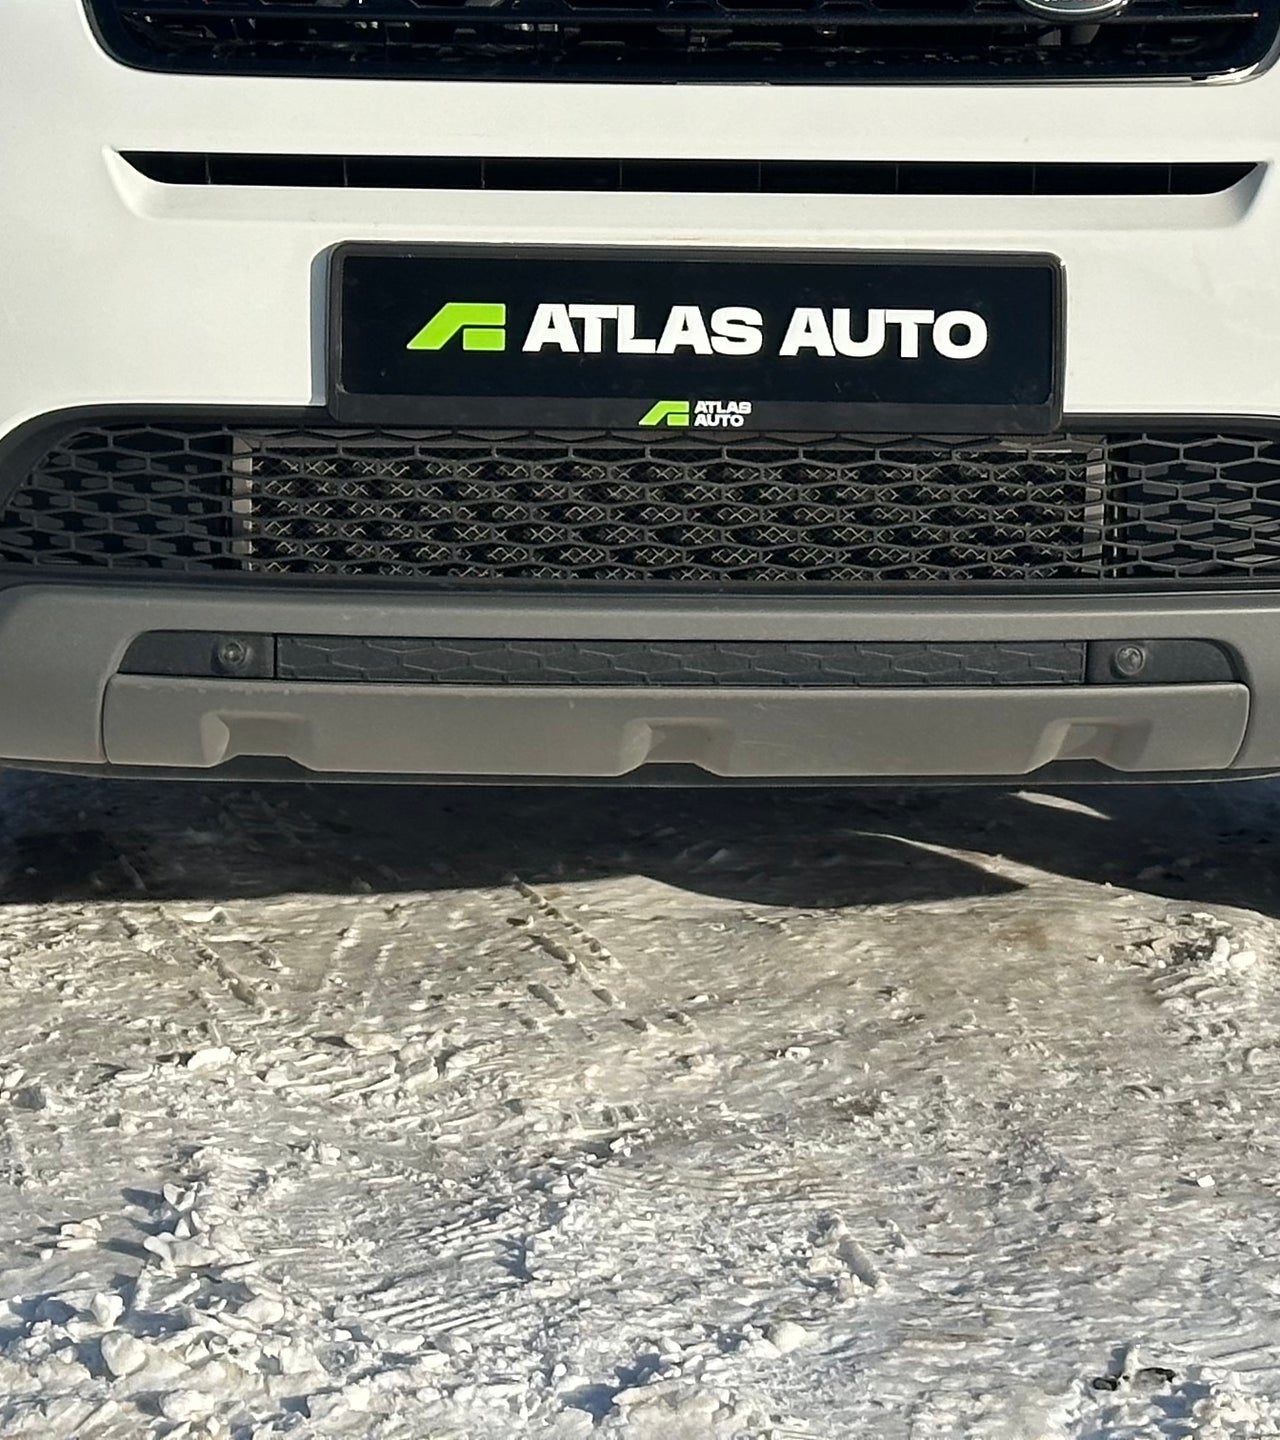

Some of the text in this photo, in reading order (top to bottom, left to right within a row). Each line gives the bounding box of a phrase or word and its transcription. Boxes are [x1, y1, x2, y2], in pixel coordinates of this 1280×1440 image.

[521, 303, 989, 359] ATLAS AUTO
[693, 400, 753, 415] ATLAS
[693, 413, 745, 427] AUTO
